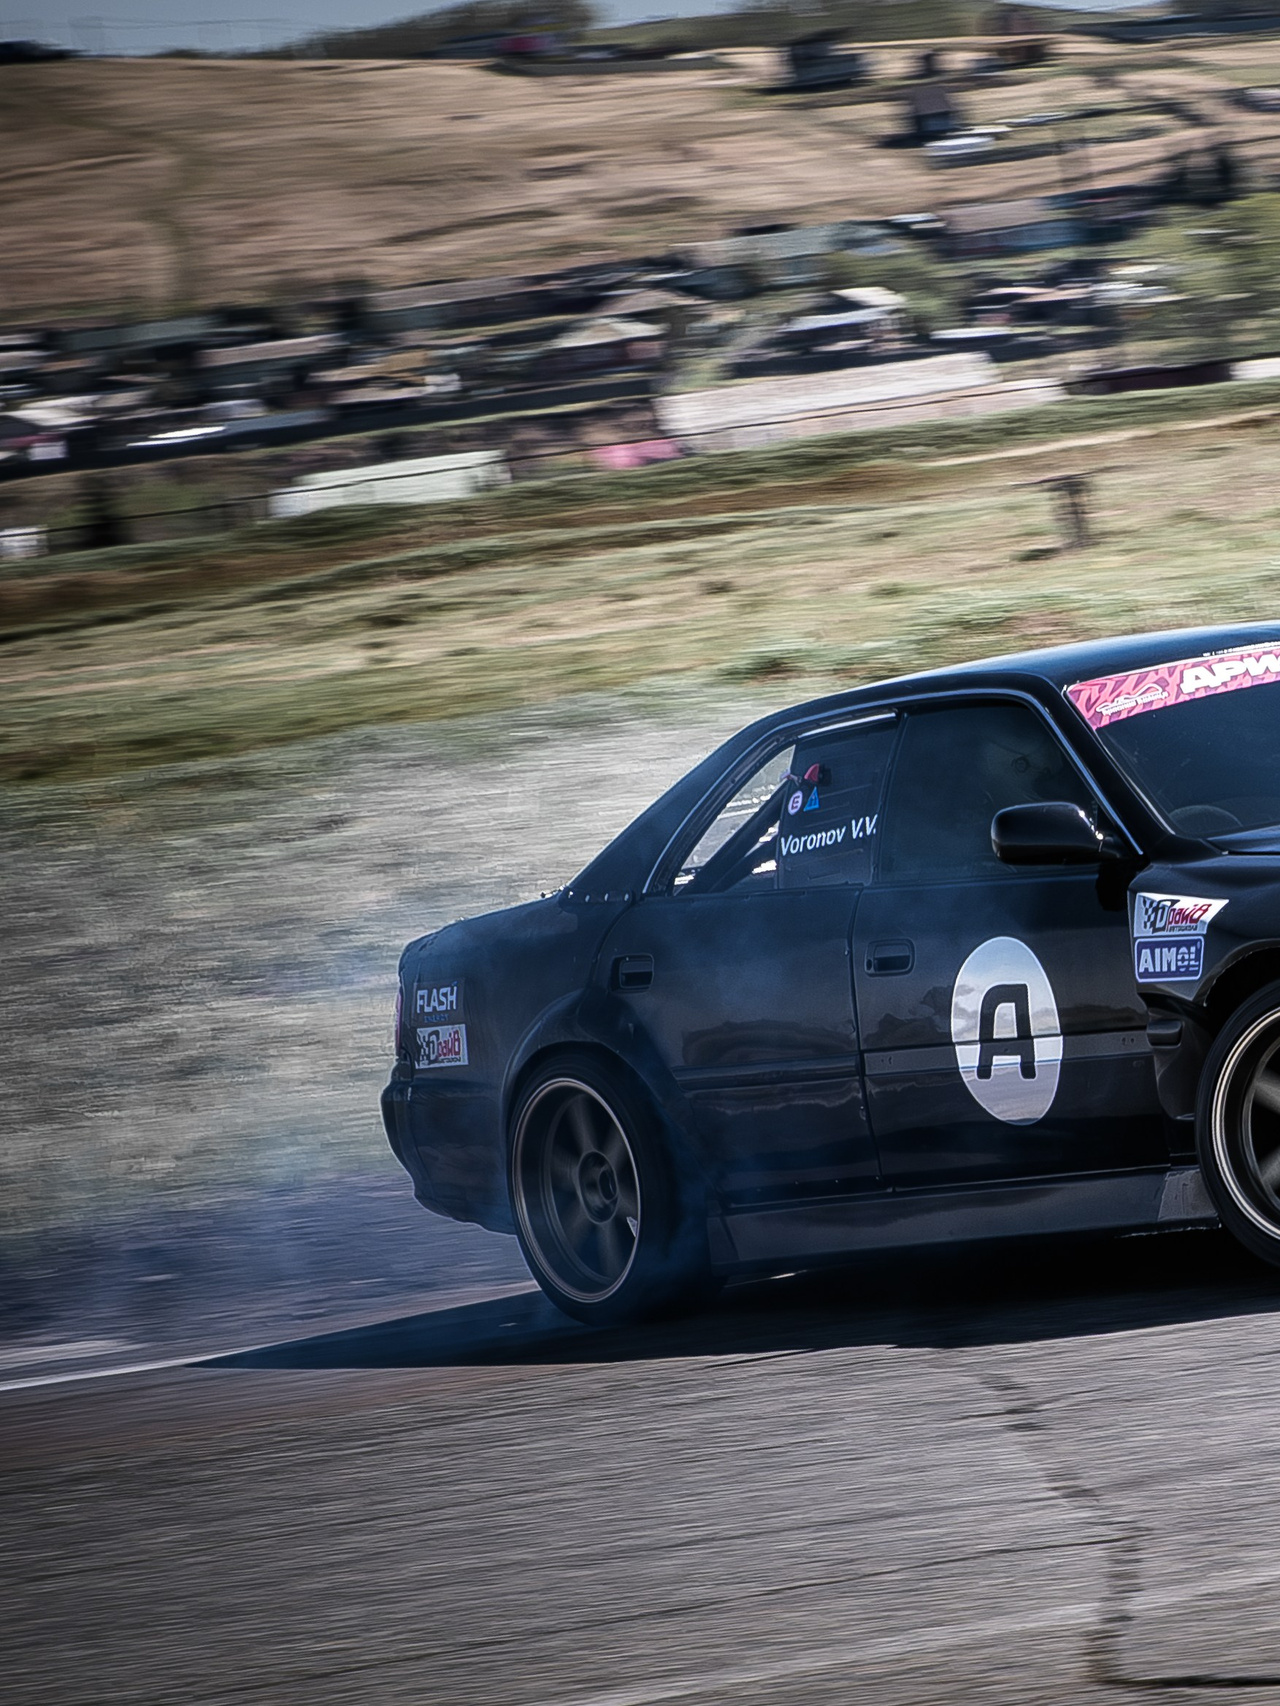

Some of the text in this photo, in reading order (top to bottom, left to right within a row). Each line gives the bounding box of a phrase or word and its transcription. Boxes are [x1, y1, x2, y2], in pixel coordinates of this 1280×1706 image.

[780, 813, 878, 857] Voronov V.V.
[1138, 945, 1200, 973] AIMOL
[416, 985, 457, 1013] FLASH
